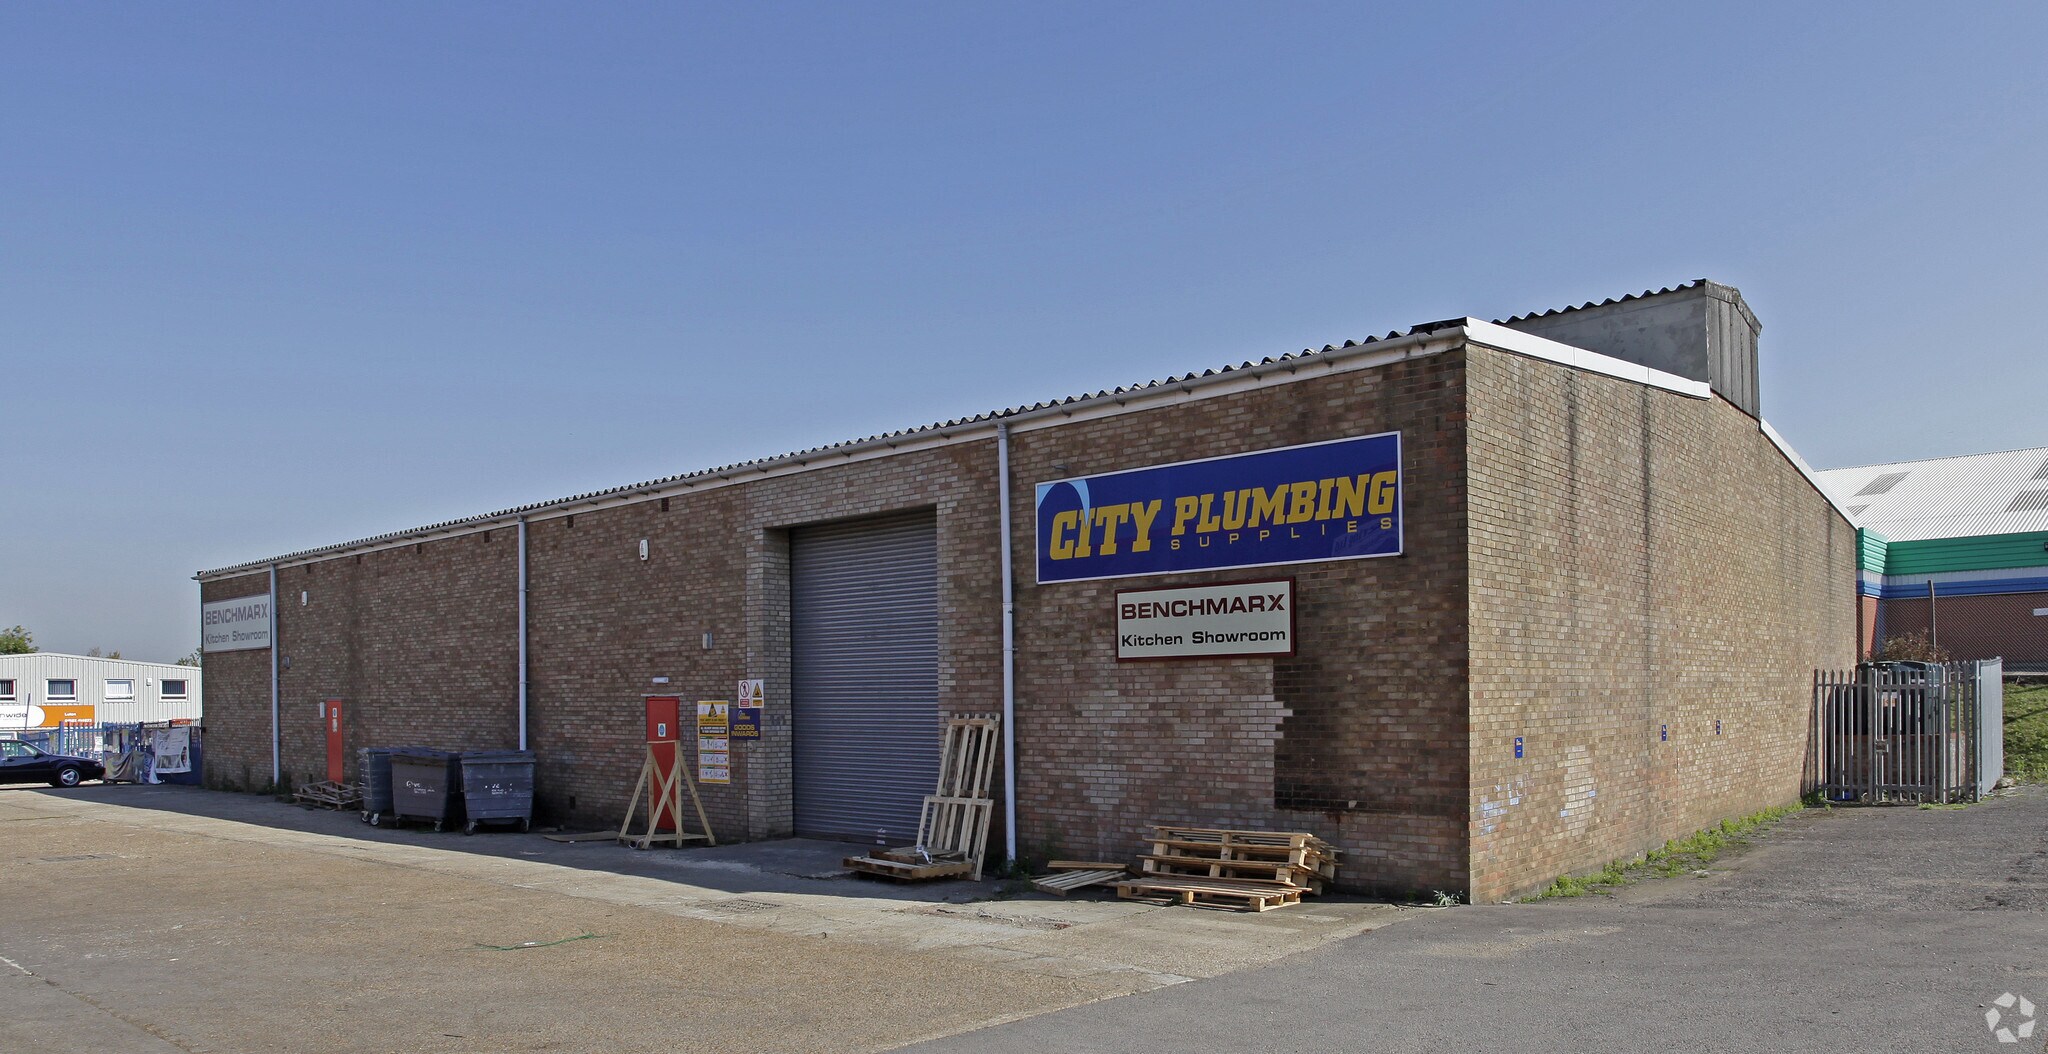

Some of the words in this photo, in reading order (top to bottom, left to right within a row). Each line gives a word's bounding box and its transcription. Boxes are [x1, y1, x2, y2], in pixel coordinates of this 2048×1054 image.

[1050, 499, 1162, 560] CITY
[1171, 470, 1397, 536] PLUMBING
[1170, 517, 1393, 550] SUPPLIES
[205, 603, 268, 626] BENCHMARX
[1121, 594, 1285, 620] BENCHMARX
[205, 634, 230, 645] Kitchen
[232, 630, 269, 641] Showroom
[1121, 634, 1183, 647] Kitchen
[1192, 630, 1286, 644] Showroom
